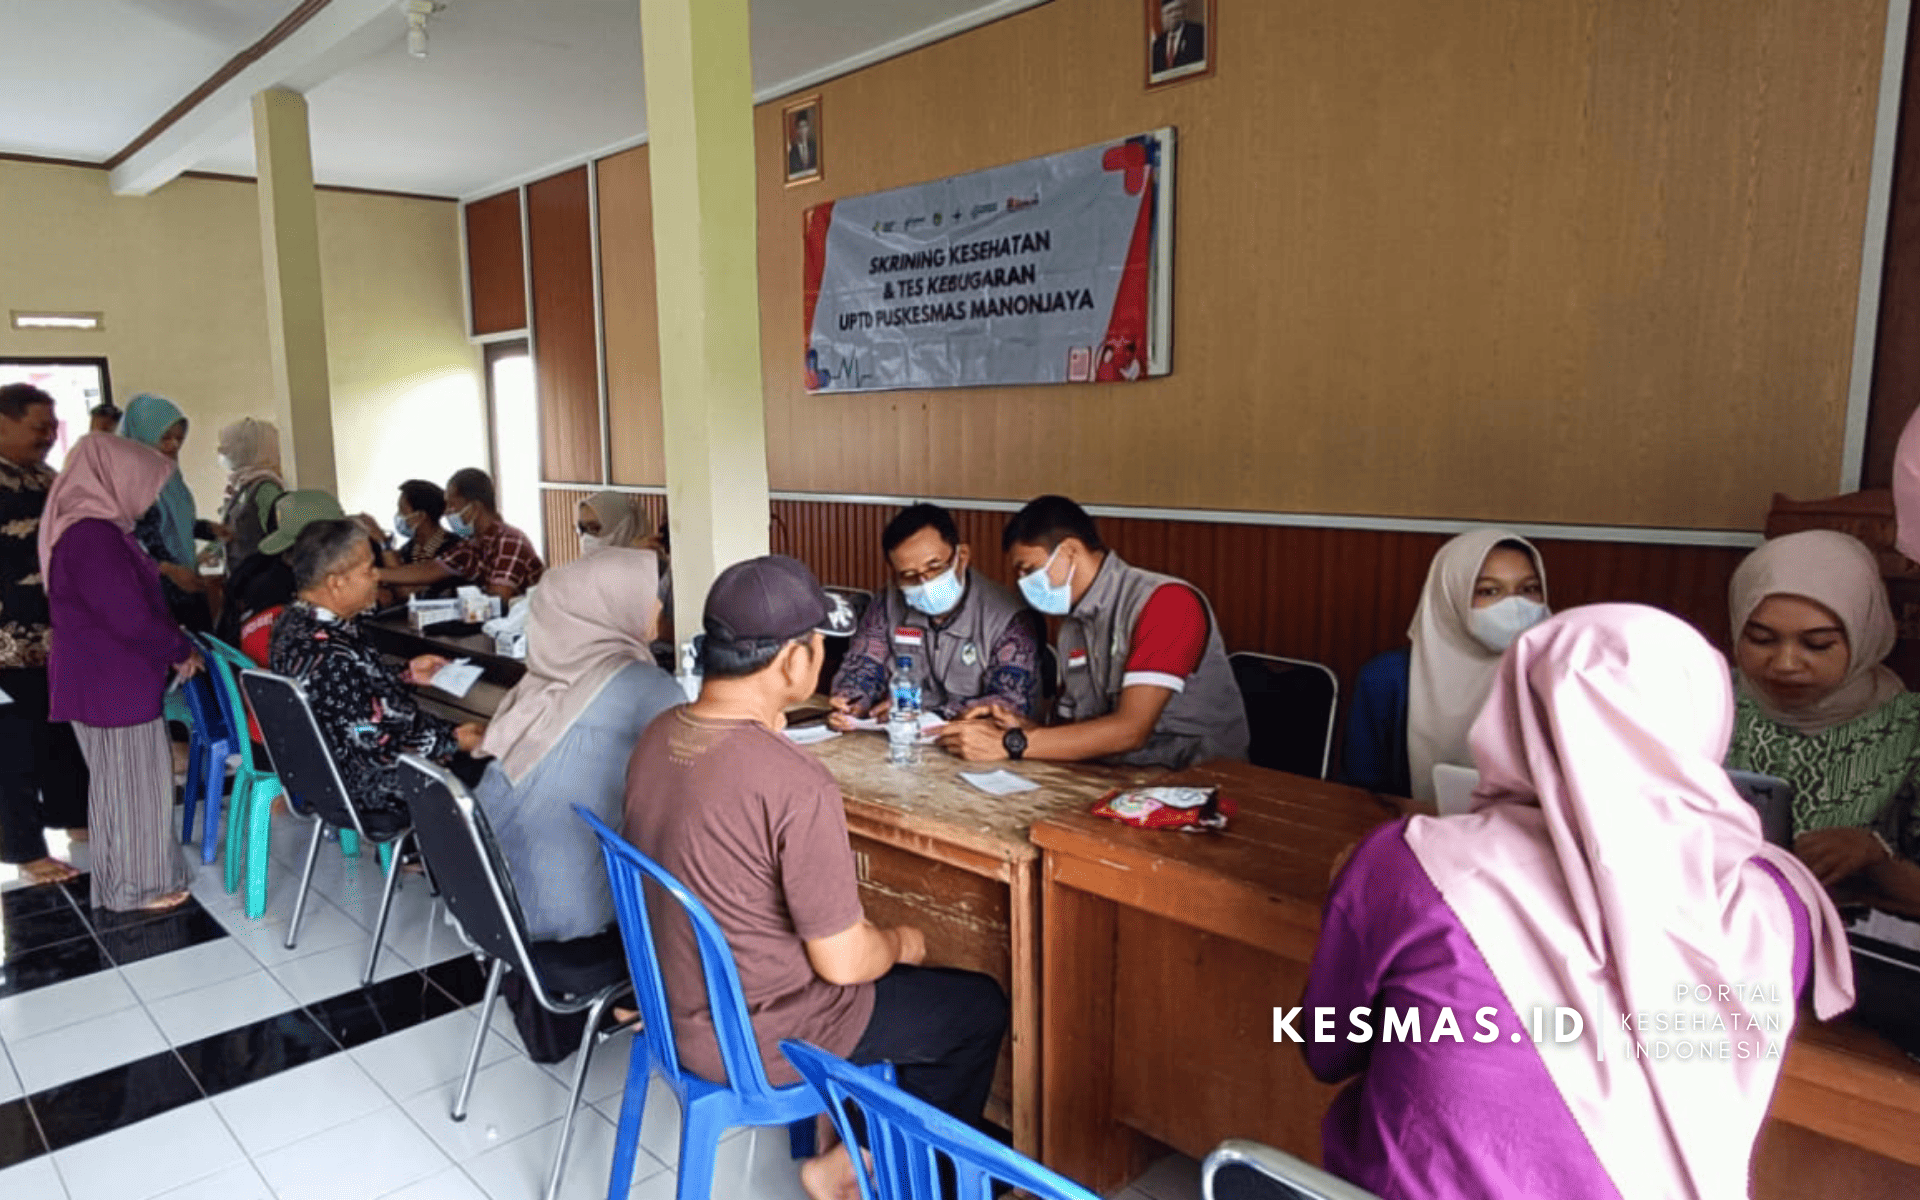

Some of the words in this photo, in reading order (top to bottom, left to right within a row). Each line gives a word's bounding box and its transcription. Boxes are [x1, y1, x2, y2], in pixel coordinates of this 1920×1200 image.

[868, 248, 945, 275] SKRINING
[949, 229, 1051, 266] KESEHATAN
[883, 281, 895, 300] &
[897, 278, 924, 298] TES
[927, 264, 1036, 295] KEBUGARAN
[839, 311, 873, 331] UPTD
[875, 301, 967, 328] PUSKESMAS
[971, 288, 1094, 319] MANONJAYA
